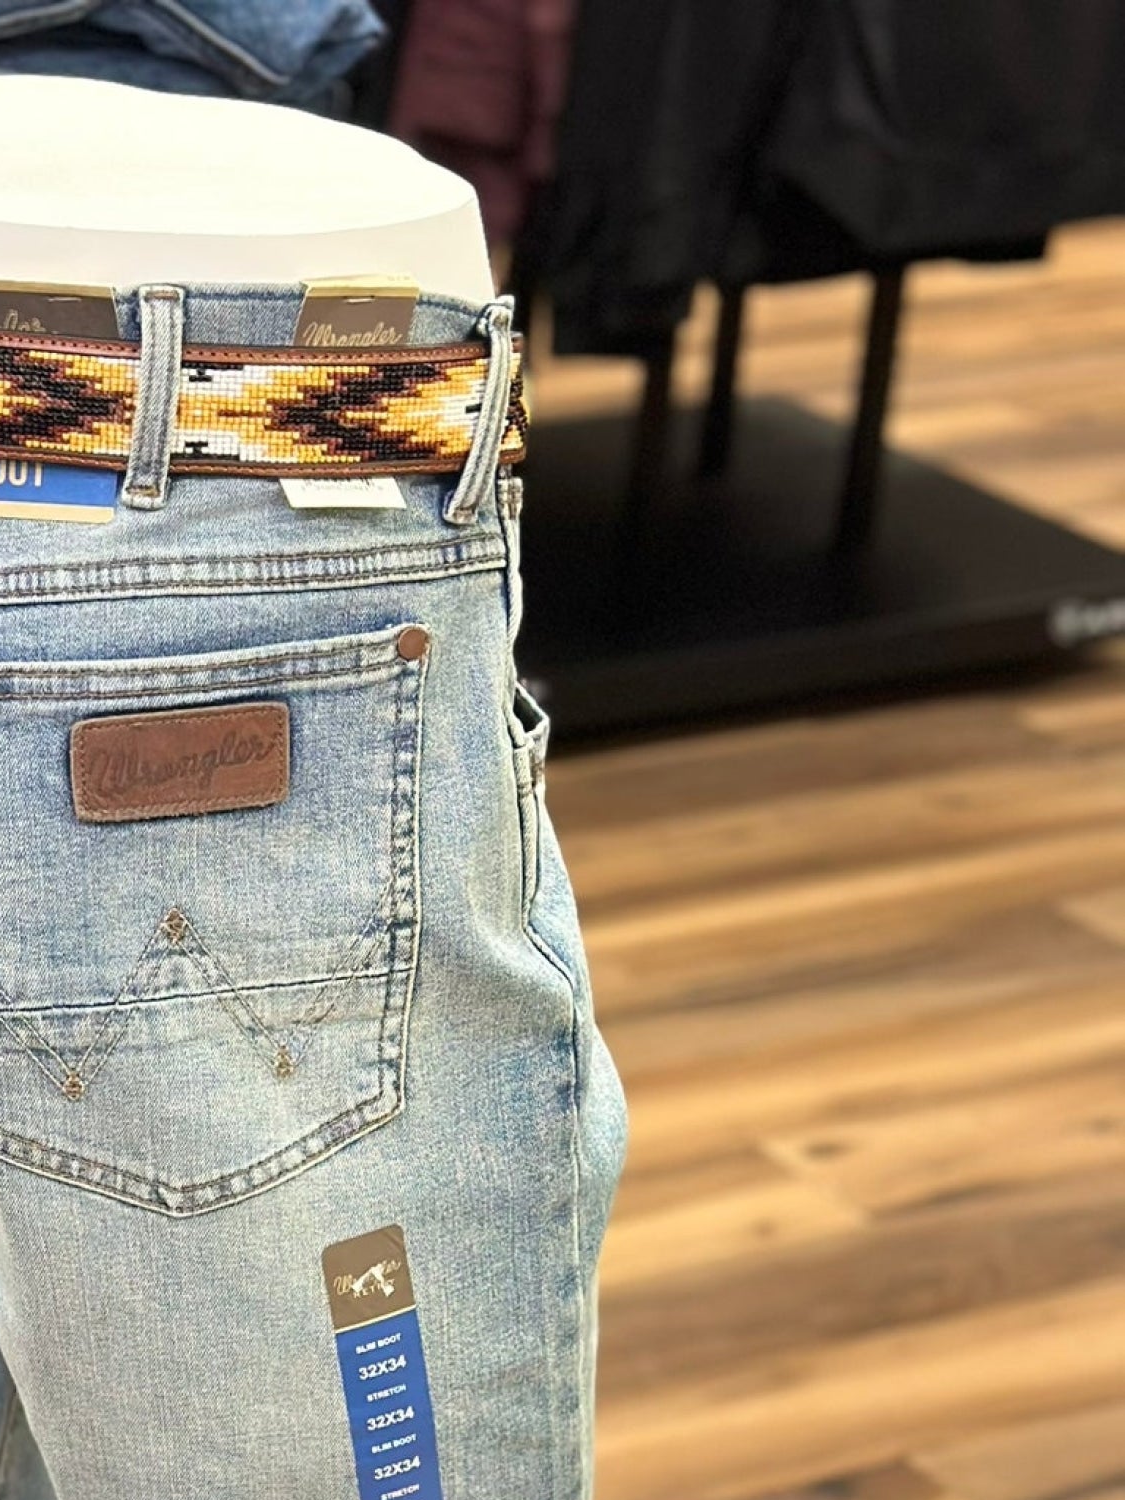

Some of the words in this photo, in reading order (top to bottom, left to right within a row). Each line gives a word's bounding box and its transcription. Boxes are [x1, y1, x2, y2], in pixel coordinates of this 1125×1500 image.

[87, 730, 277, 799] Wrangler
[377, 1332, 401, 1347] BOOT
[358, 1355, 407, 1380] 32X34
[366, 1405, 414, 1431] 32X34
[393, 1433, 417, 1448] BOOT
[374, 1455, 421, 1480] 32X34
